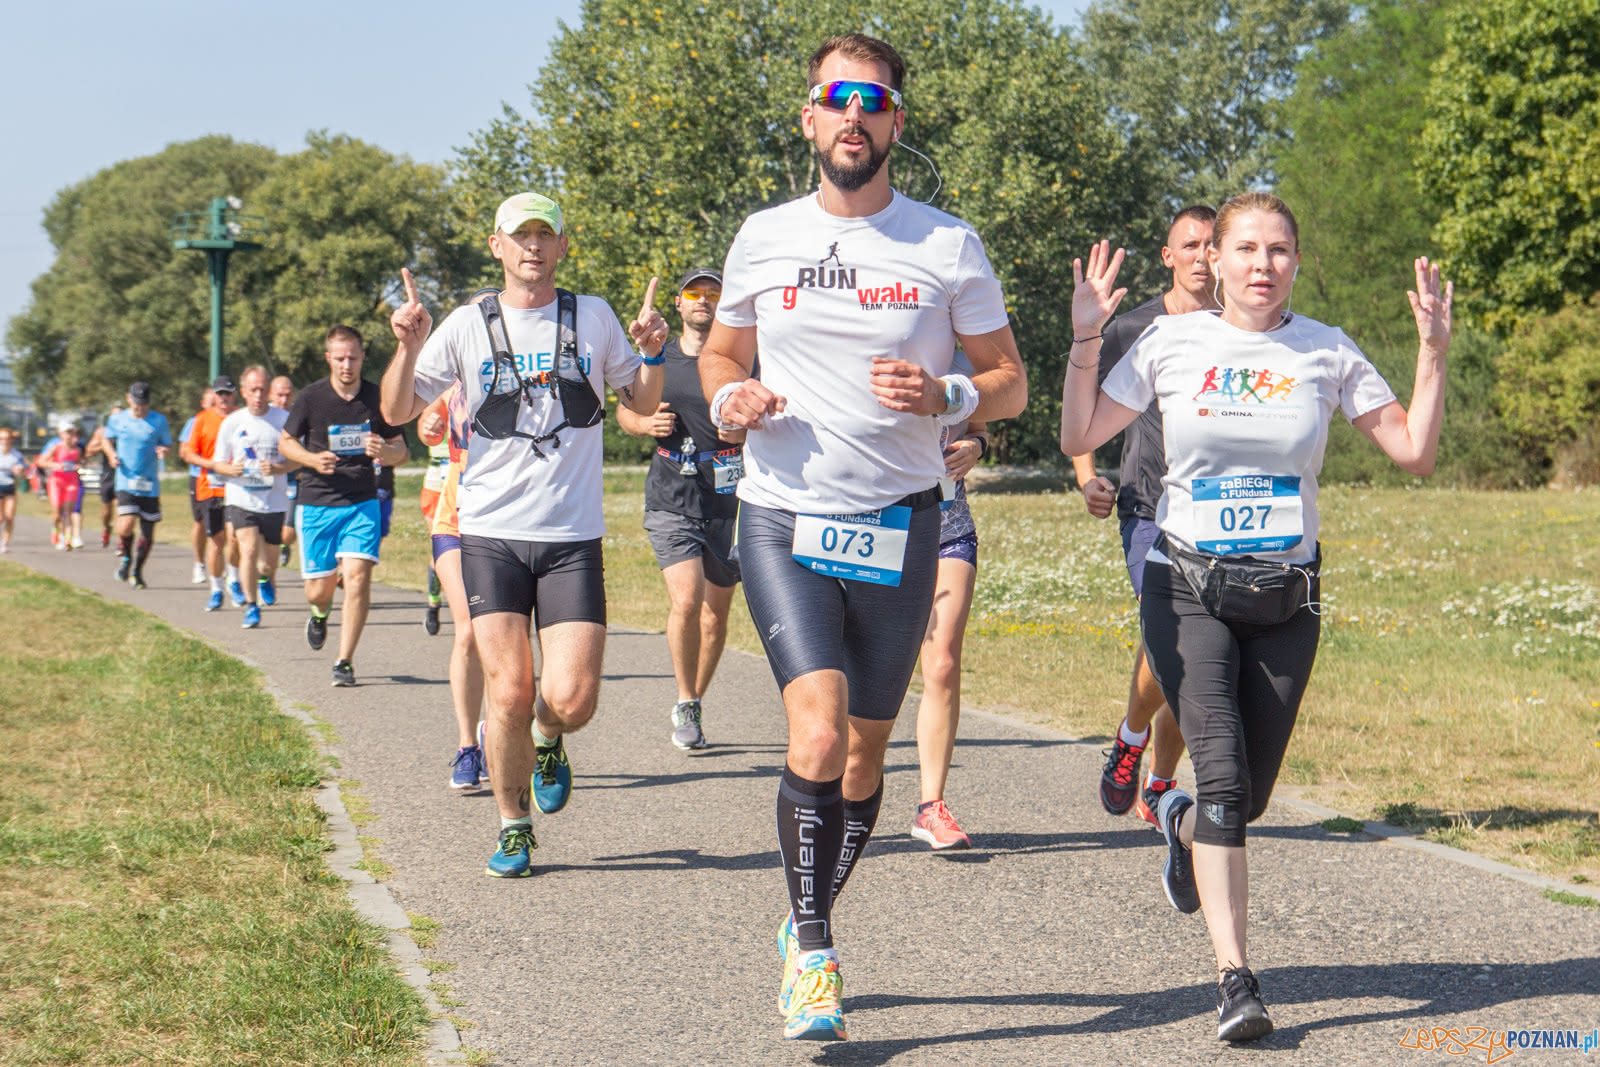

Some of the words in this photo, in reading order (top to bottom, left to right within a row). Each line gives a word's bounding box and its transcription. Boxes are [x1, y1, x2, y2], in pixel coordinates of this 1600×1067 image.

[860, 303, 883, 311] TEAM
[339, 435, 361, 447] 630
[1219, 477, 1273, 491] zaBIEGaj
[1229, 489, 1274, 499] FUNdusze
[834, 512, 881, 525] FUNdusze
[1220, 504, 1273, 532] 027
[822, 527, 875, 558] 073
